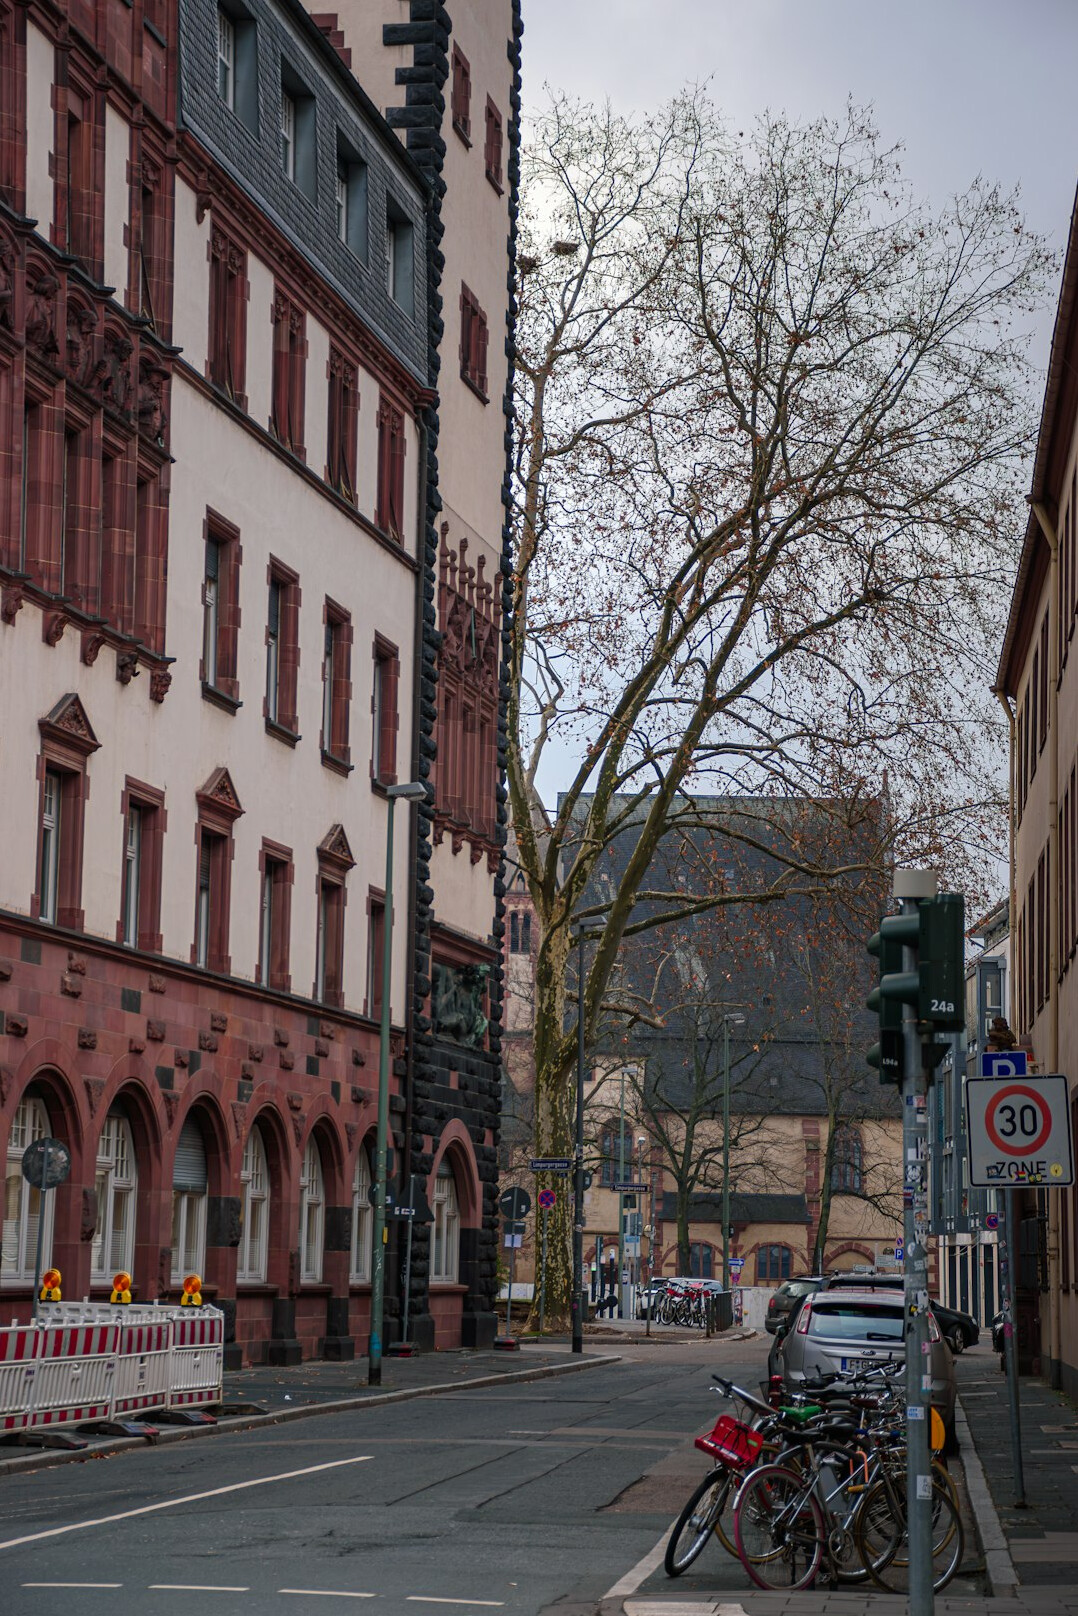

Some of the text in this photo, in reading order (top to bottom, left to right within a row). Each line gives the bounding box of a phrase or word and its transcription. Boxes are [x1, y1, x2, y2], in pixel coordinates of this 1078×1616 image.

[931, 999, 955, 1013] 24a
[999, 1104, 1038, 1137] 30
[996, 1161, 1047, 1179] ZONE
[896, 1249, 902, 1259] P
